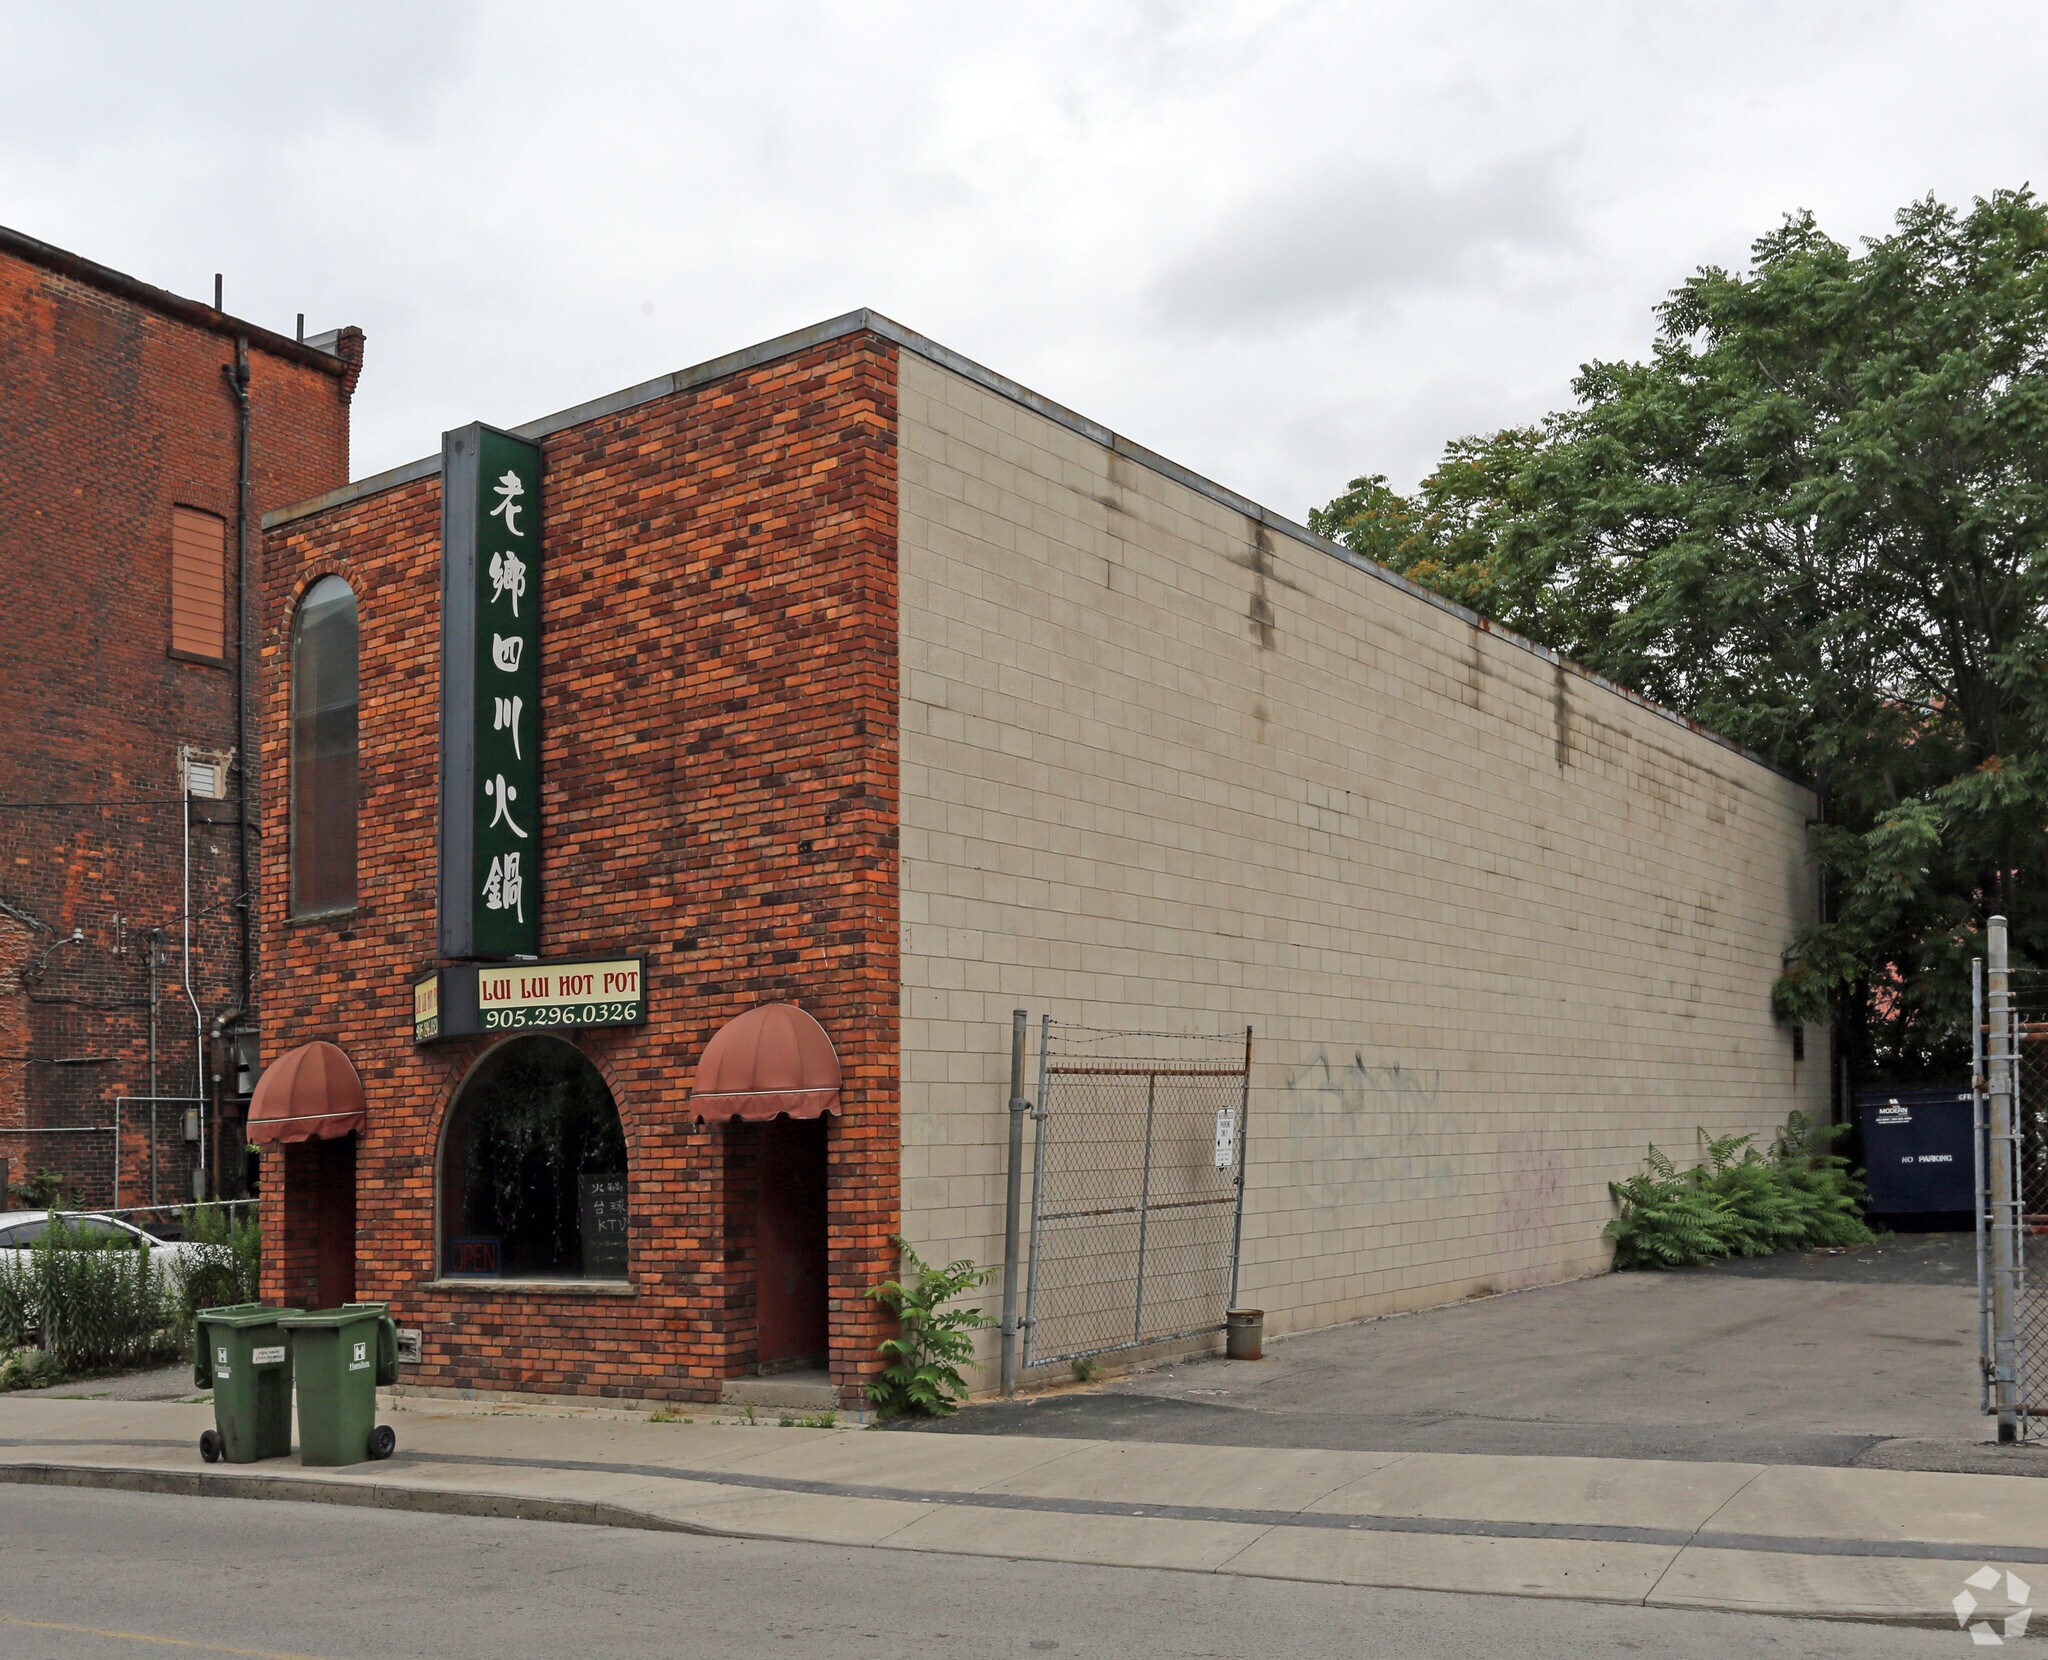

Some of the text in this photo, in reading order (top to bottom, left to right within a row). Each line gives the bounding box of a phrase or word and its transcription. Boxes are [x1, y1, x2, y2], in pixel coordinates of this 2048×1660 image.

[482, 971, 638, 1001] LUI LUI HOT POT
[485, 1002, 637, 1029] 905.296.0326
[1918, 1154, 1953, 1163] PARKING
[598, 1217, 627, 1232] KTV
[451, 1243, 497, 1272] OPEN
